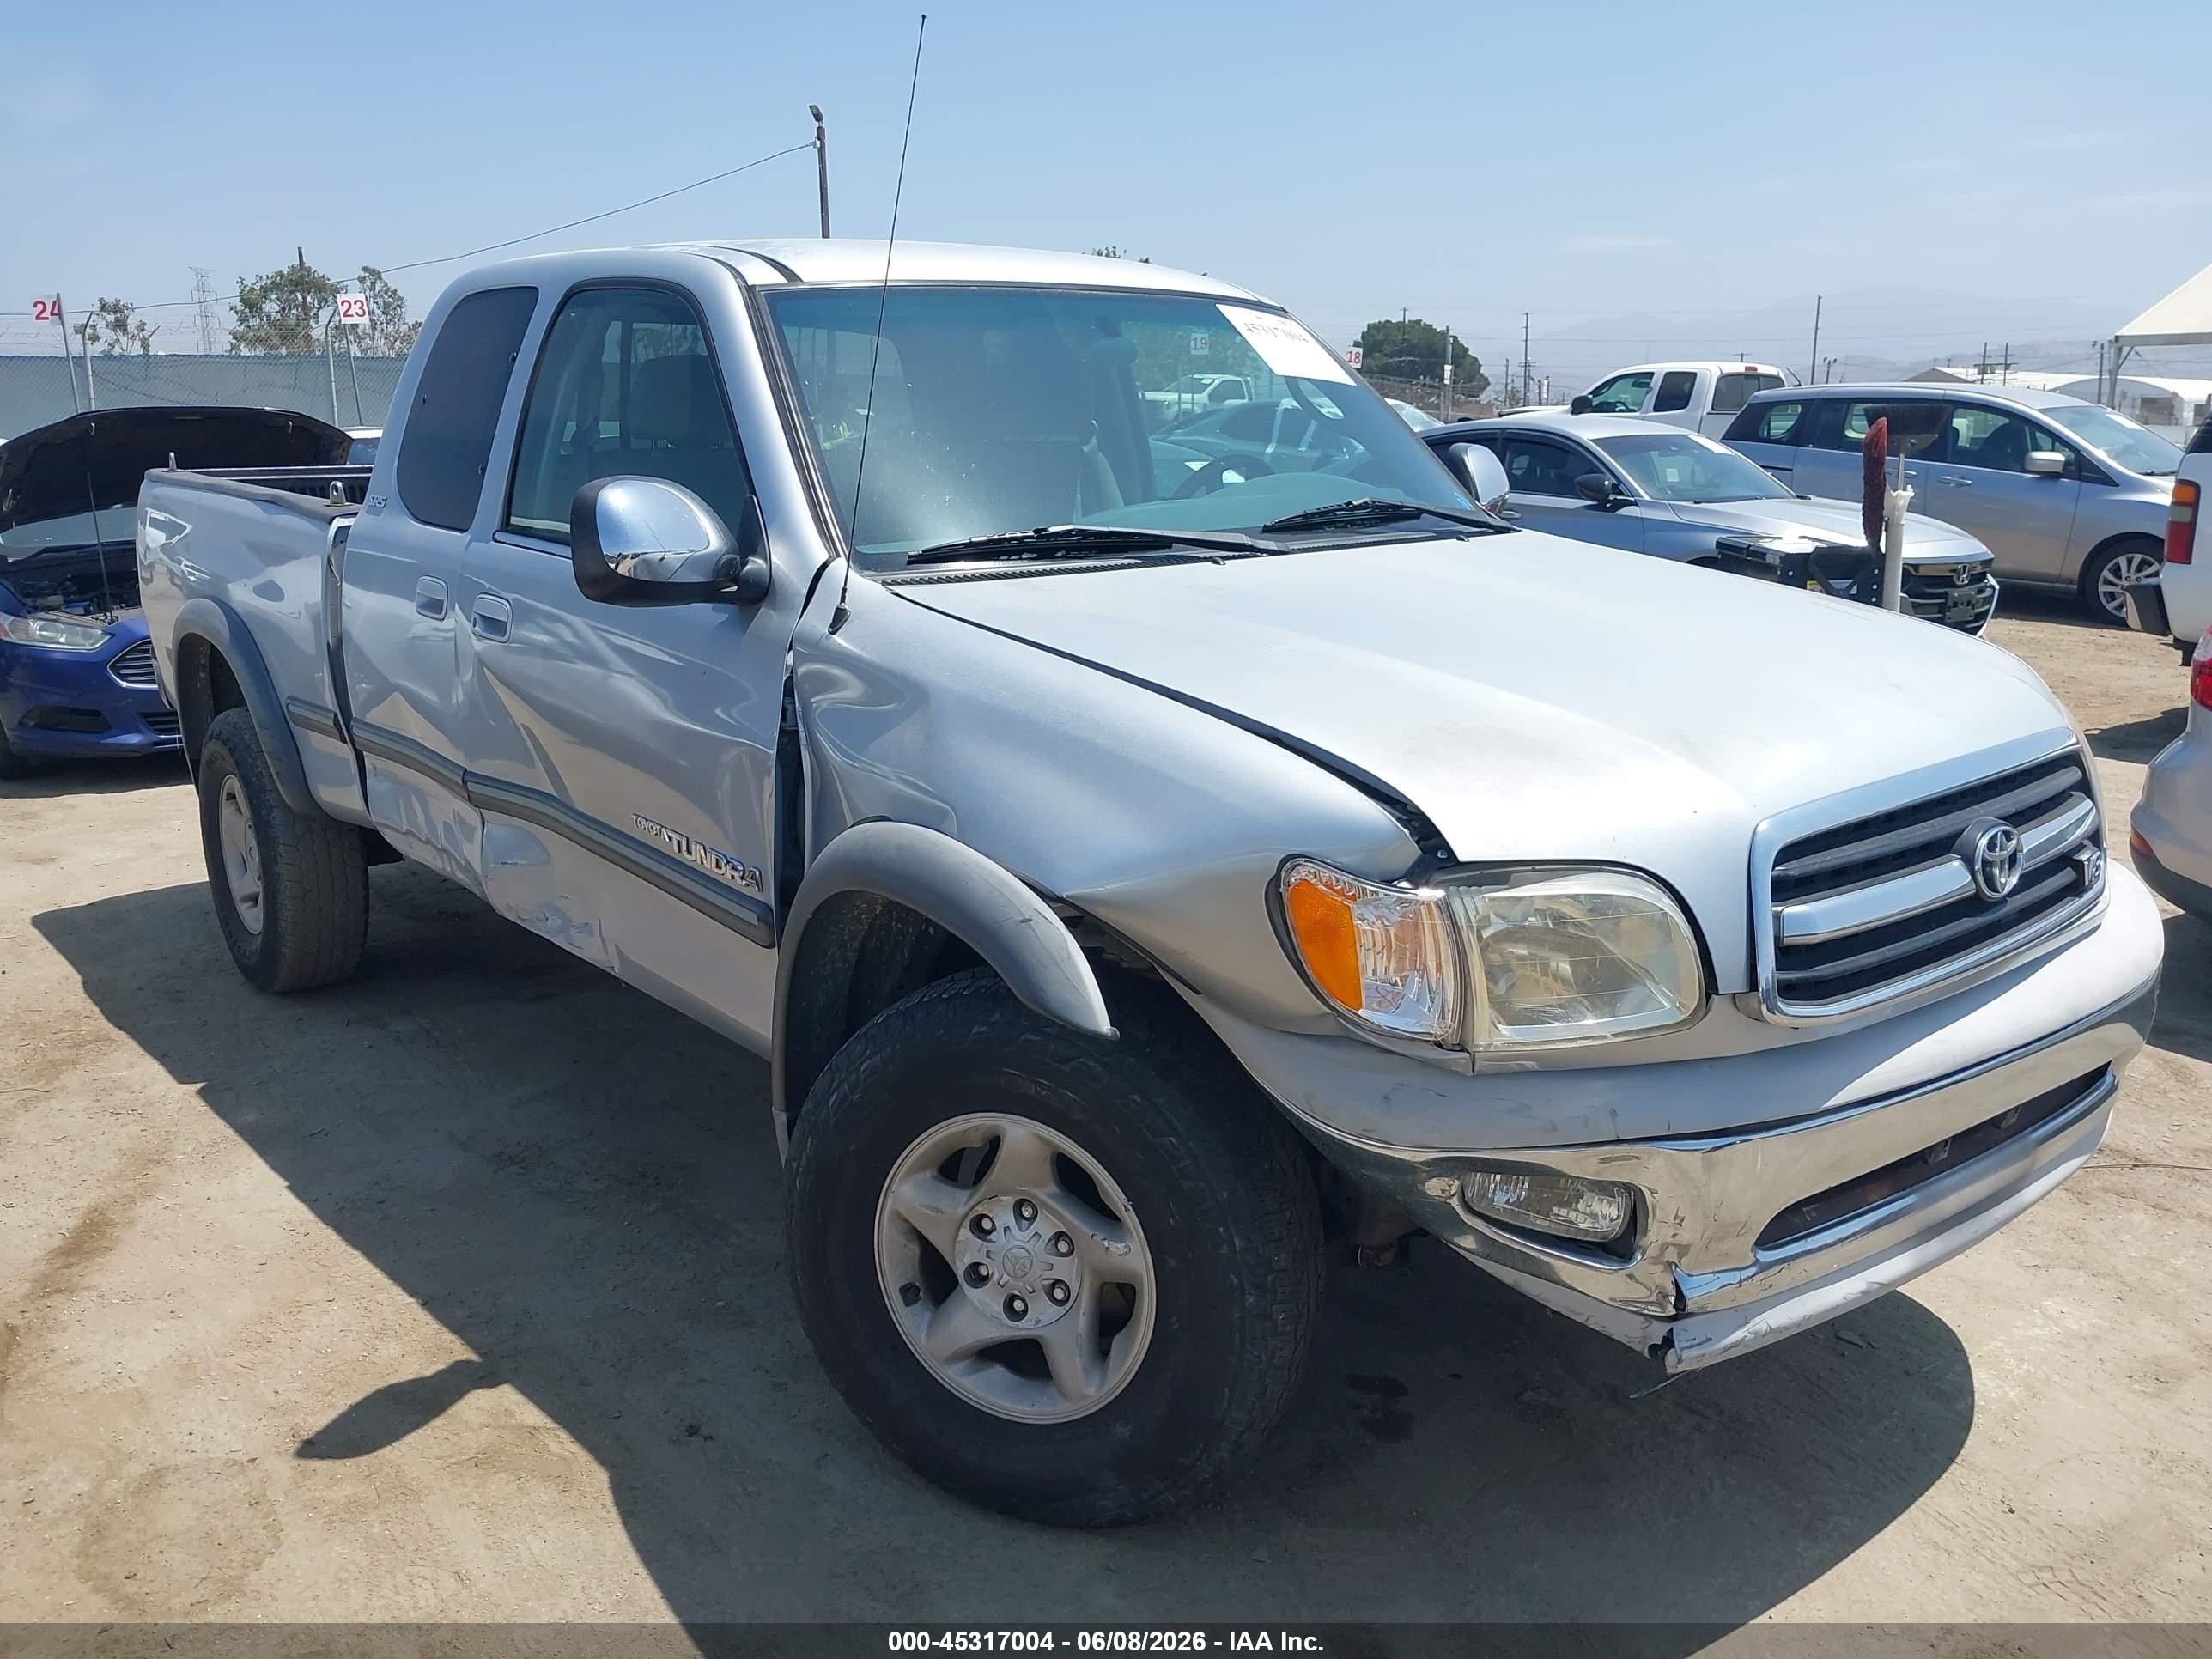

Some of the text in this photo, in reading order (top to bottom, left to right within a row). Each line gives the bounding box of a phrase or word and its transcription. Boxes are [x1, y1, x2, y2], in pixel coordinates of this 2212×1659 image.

[33, 300, 63, 321] 24
[340, 299, 367, 318] 23
[1192, 337, 1207, 351] 19
[1346, 350, 1361, 364] 18
[630, 813, 763, 893] TOYOTA TUNDRA
